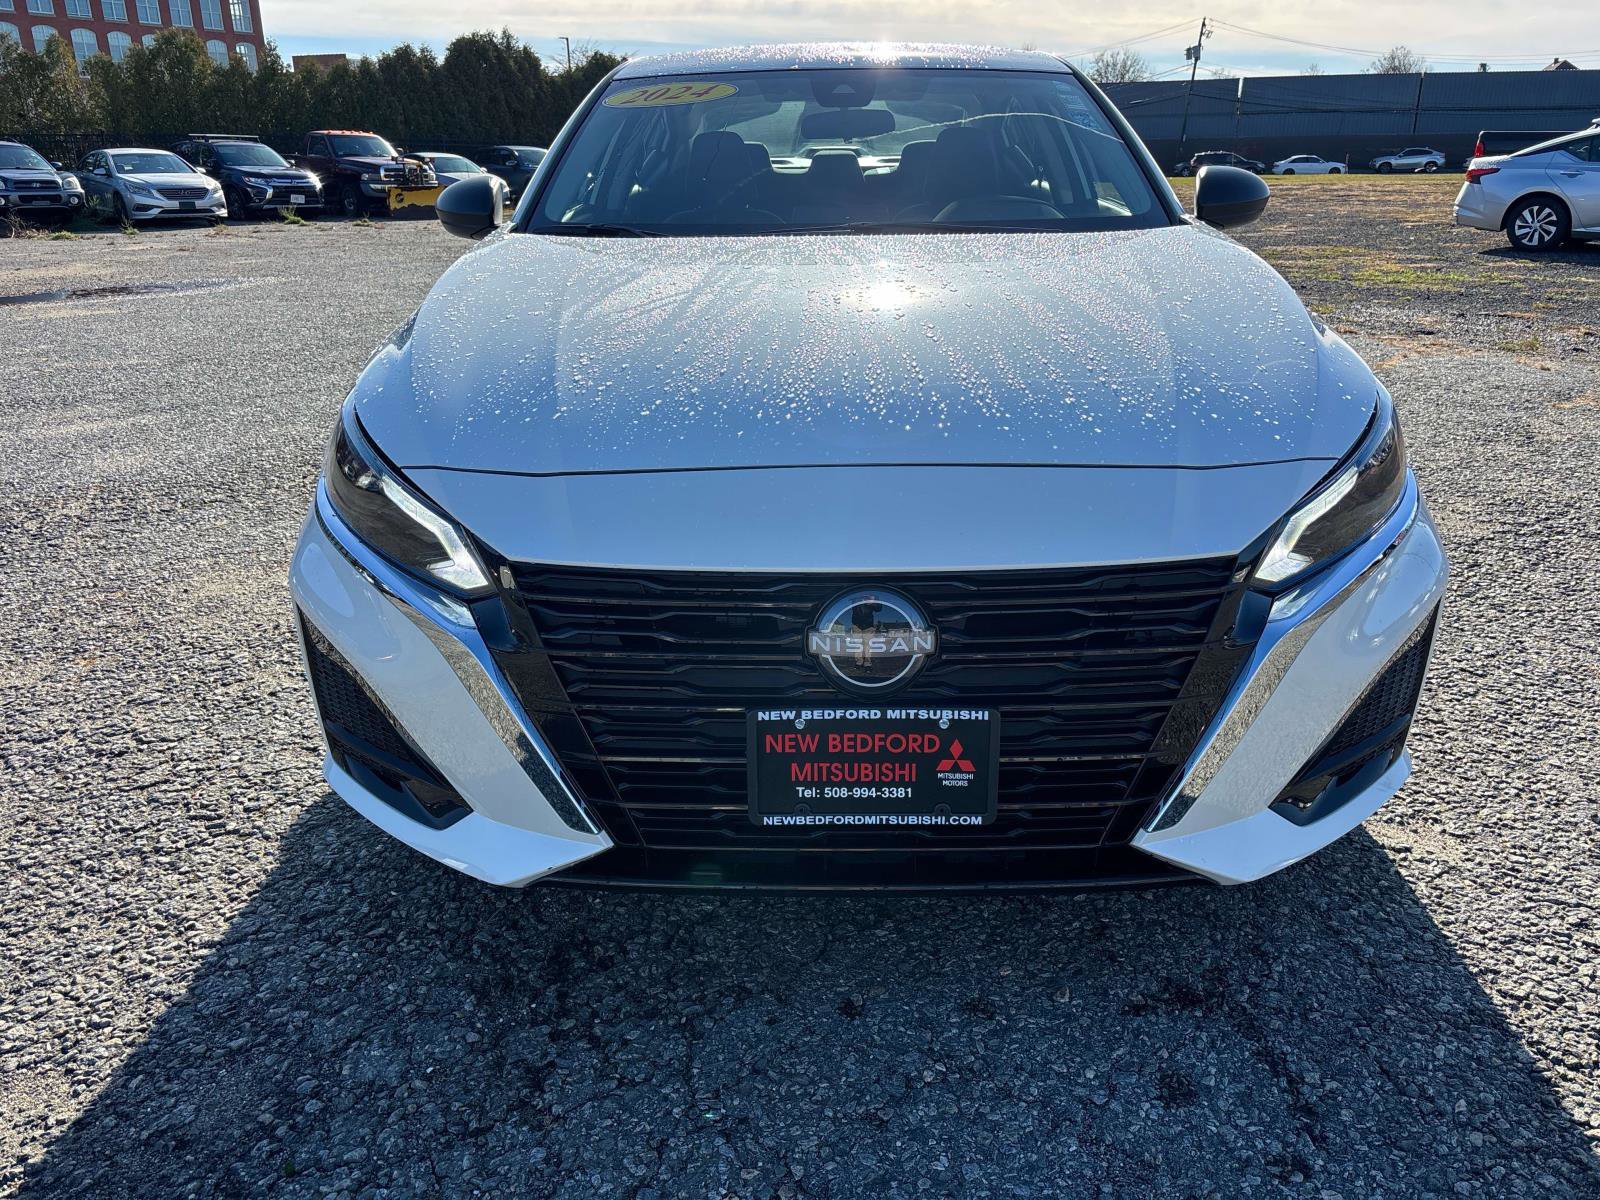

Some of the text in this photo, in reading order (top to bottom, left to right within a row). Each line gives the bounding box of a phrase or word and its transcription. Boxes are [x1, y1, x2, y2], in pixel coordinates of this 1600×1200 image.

[619, 84, 721, 105] 2024
[811, 635, 933, 653] NISSAN
[757, 709, 989, 721] NEW BEDFORD MITSUBISHI
[764, 733, 941, 753] NEW BEDFORD
[790, 762, 917, 782] MITSUBISHI
[937, 772, 974, 780] MITSUBISHI
[796, 786, 912, 798] Tel: 508-994-3381
[763, 815, 982, 826] NEWBEDFORDMITSUBISHI.COM
